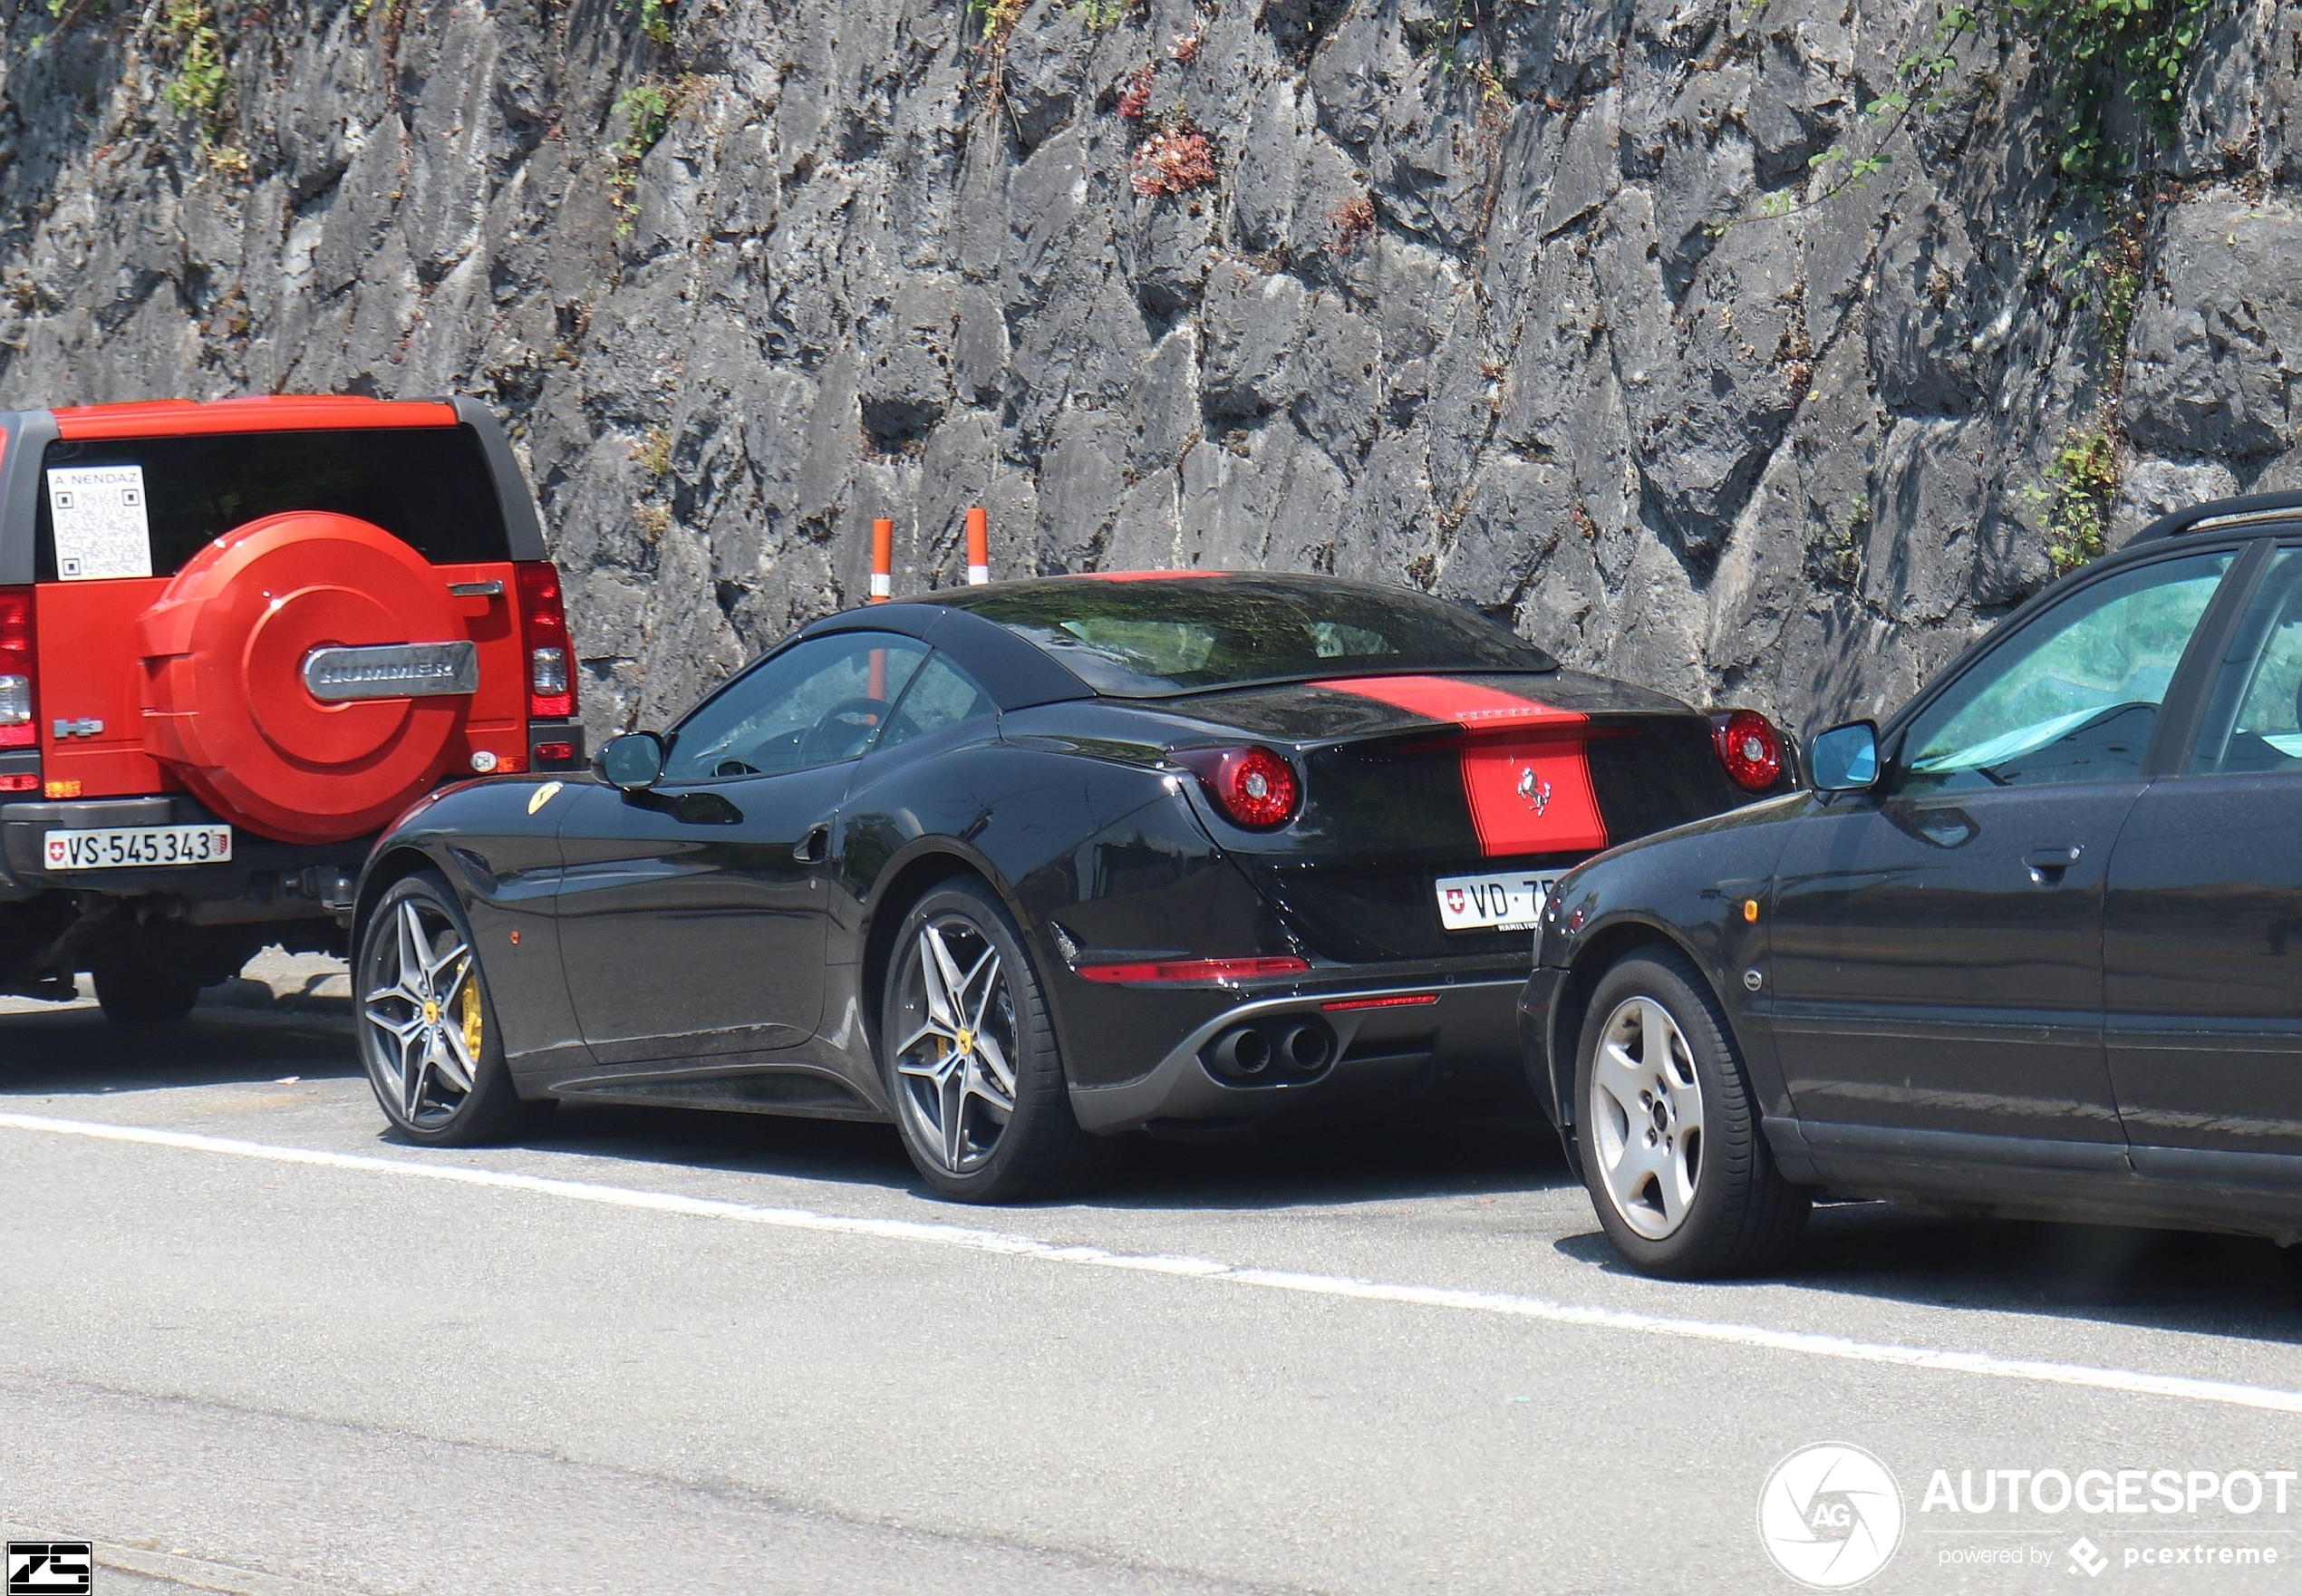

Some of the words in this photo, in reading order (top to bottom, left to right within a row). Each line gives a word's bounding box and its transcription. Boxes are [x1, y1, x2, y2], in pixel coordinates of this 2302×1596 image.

[54, 476, 65, 485] A
[72, 472, 137, 485] NENDAZ
[320, 663, 453, 683] HUMMER
[53, 719, 103, 738] H3
